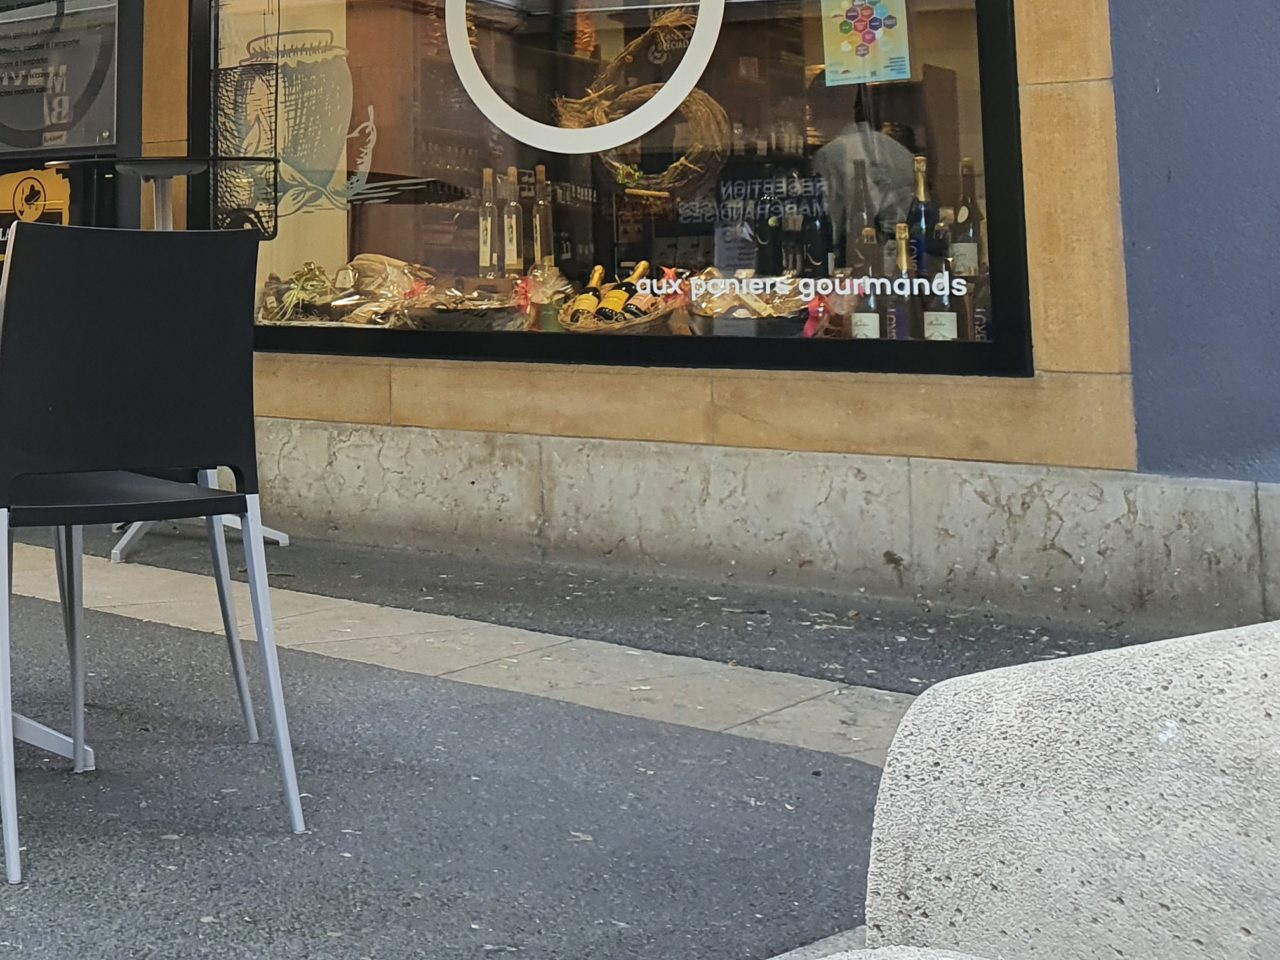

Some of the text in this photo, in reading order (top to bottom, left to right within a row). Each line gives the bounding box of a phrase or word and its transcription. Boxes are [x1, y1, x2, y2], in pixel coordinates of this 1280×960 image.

[636, 271, 968, 301] aux paniers gourmands
